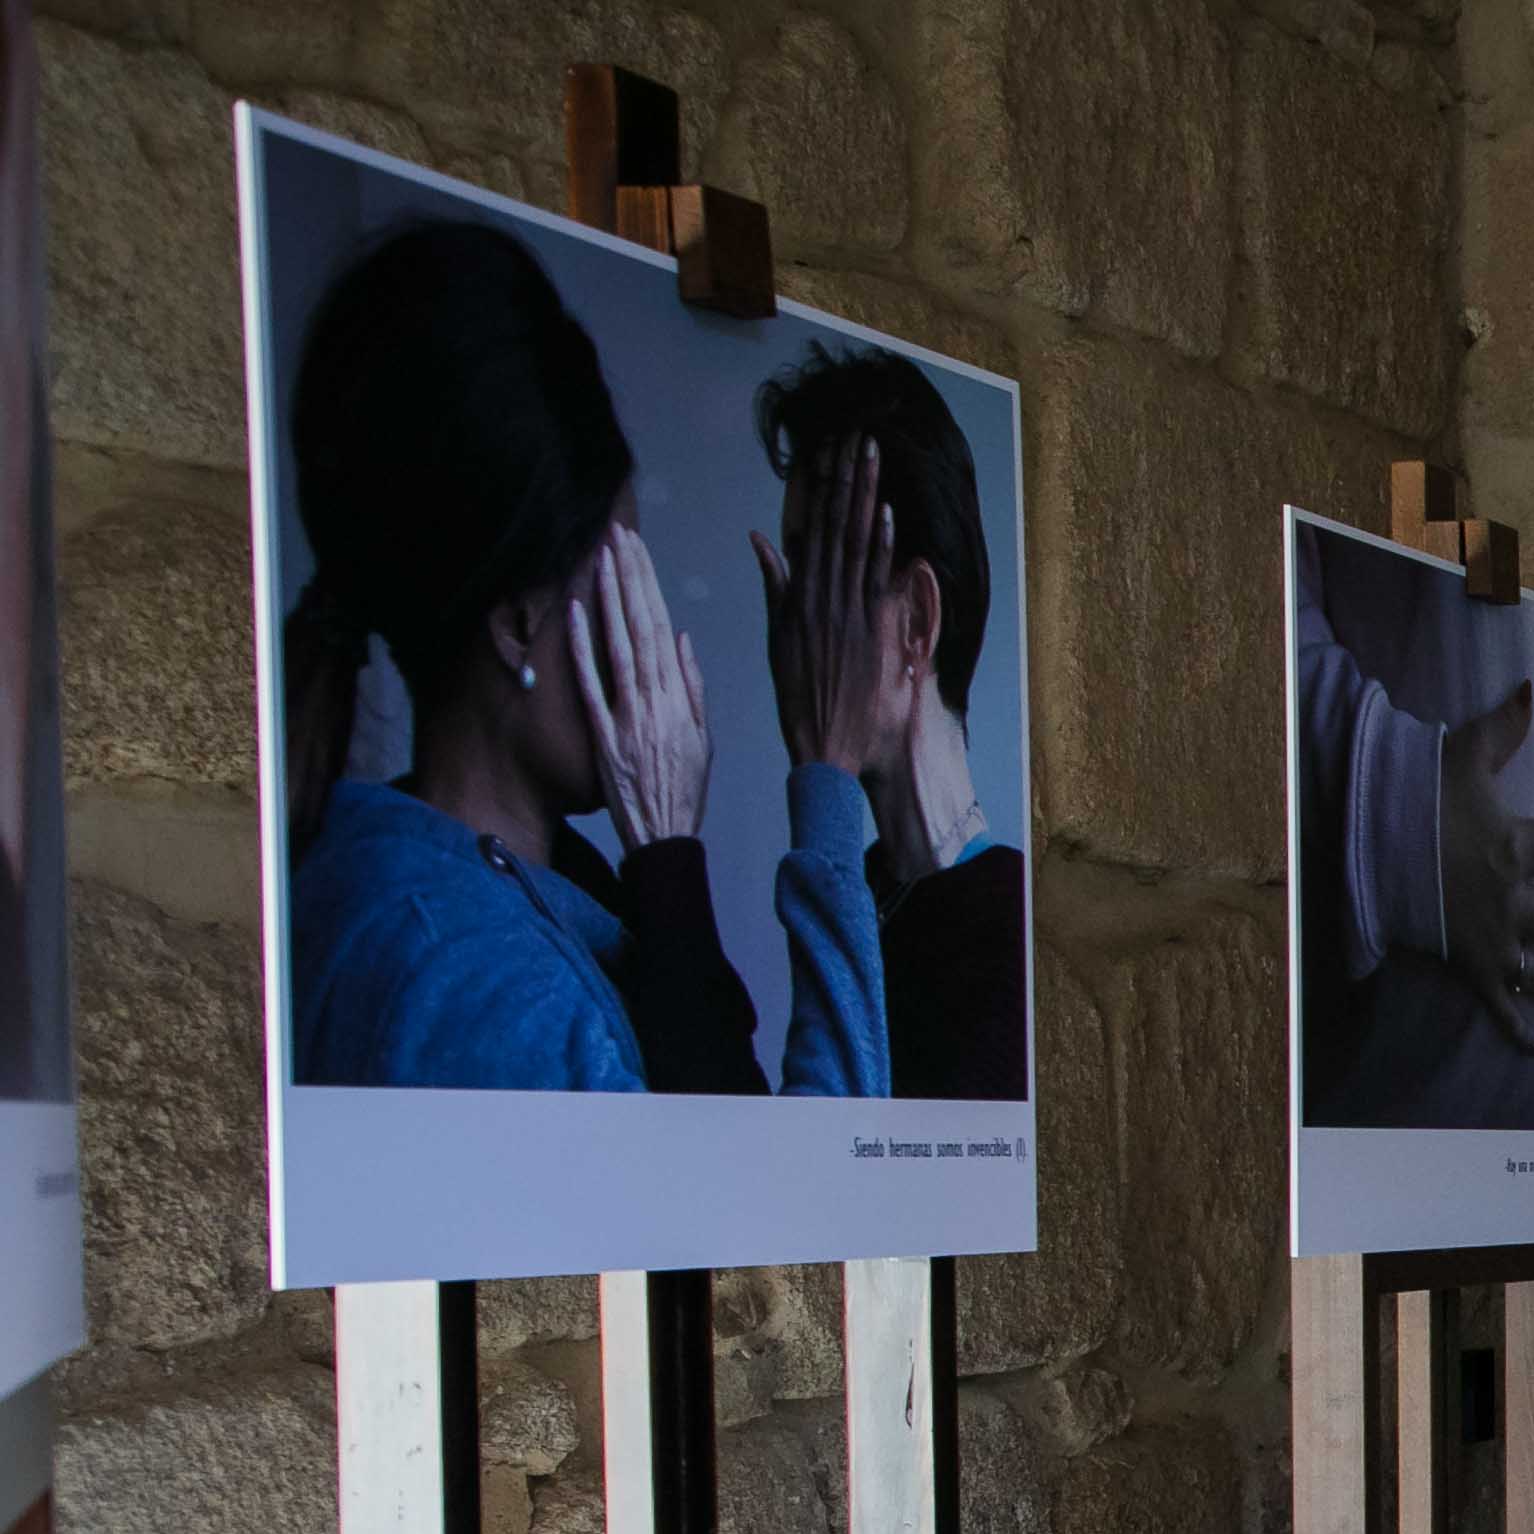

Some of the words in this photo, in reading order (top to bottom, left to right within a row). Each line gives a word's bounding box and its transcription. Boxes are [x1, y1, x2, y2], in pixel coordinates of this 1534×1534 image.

[889, 1137, 933, 1158] hermanas
[936, 1143, 964, 1158] somos
[966, 1137, 1012, 1159] invencibles
